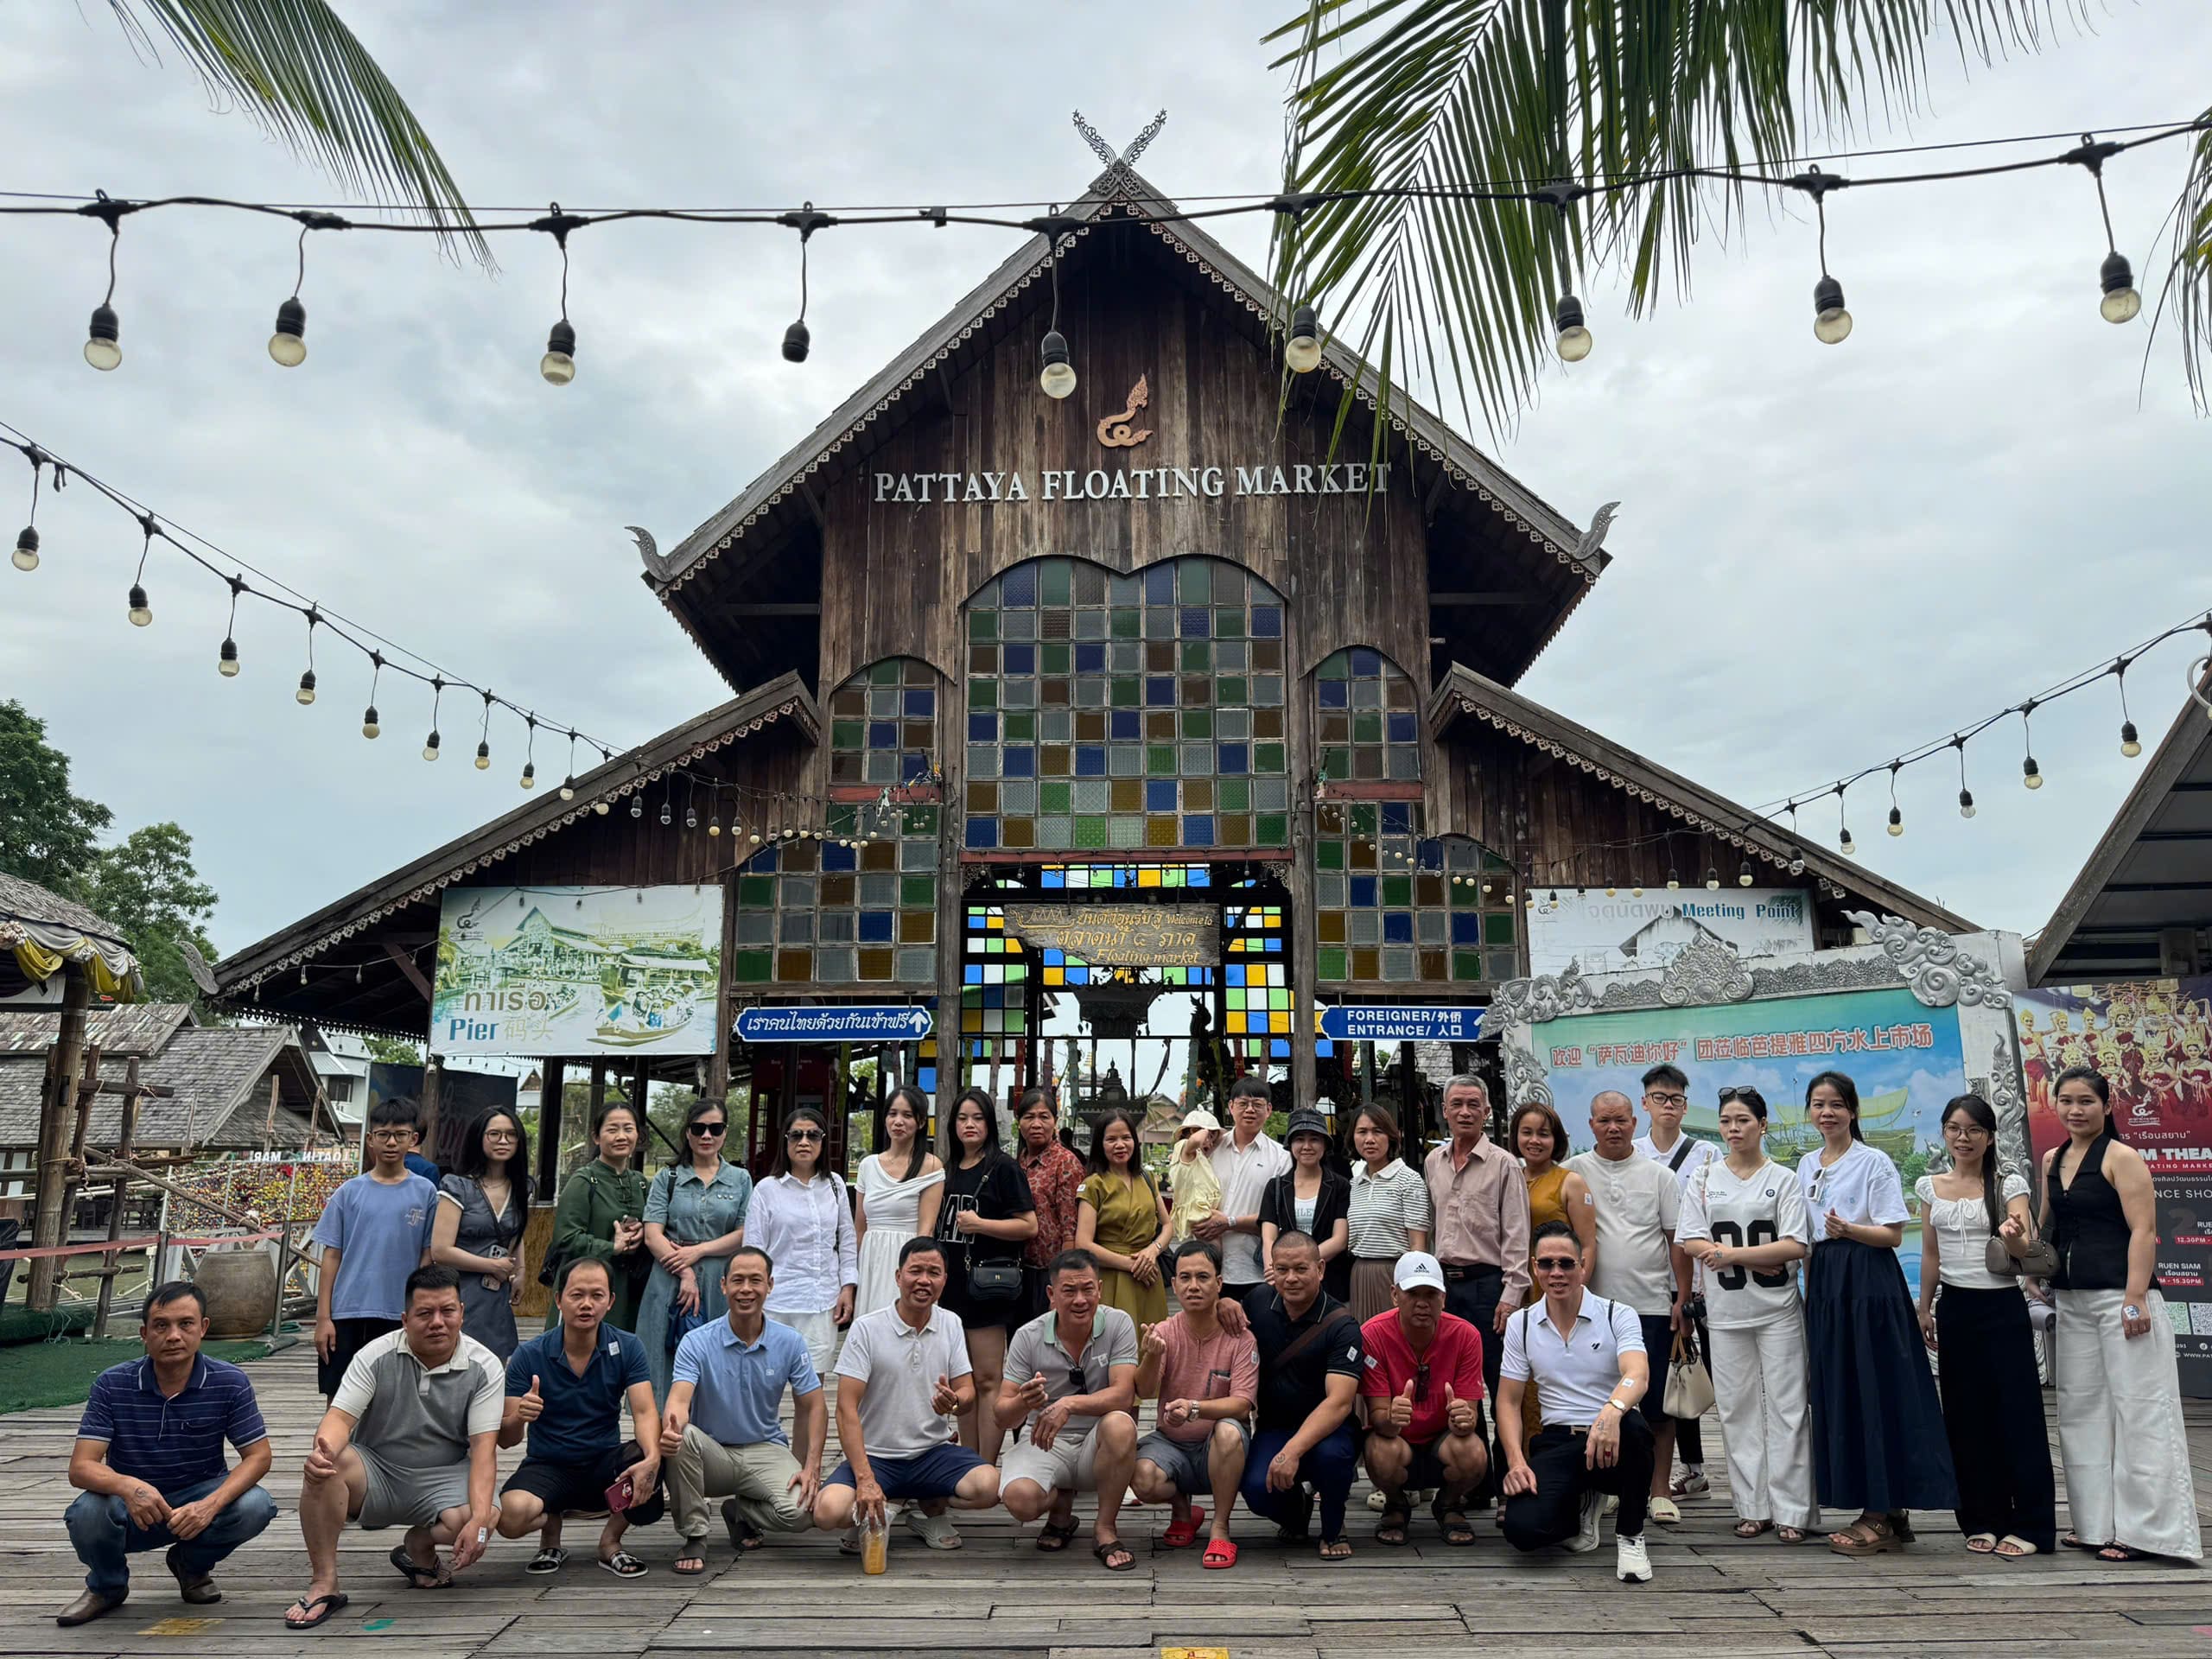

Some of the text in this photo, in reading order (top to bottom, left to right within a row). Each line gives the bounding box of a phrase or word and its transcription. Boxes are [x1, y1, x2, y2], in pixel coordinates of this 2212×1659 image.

[874, 461, 1392, 503] PATTAYA FLOATING MARKET
[1166, 912, 1213, 926] Welcome to
[1681, 903, 1798, 920] Meeting Point
[1090, 948, 1201, 965] Floating market
[463, 982, 548, 1012] ท่าเรือ
[448, 1018, 499, 1041] Pier
[504, 1017, 554, 1042] 码头
[747, 1010, 910, 1031] เราคนไทยด้วยกันเข้าฟรี
[1347, 1025, 1431, 1037] ENTRANCE/
[2154, 1189, 2181, 1198] NCE
